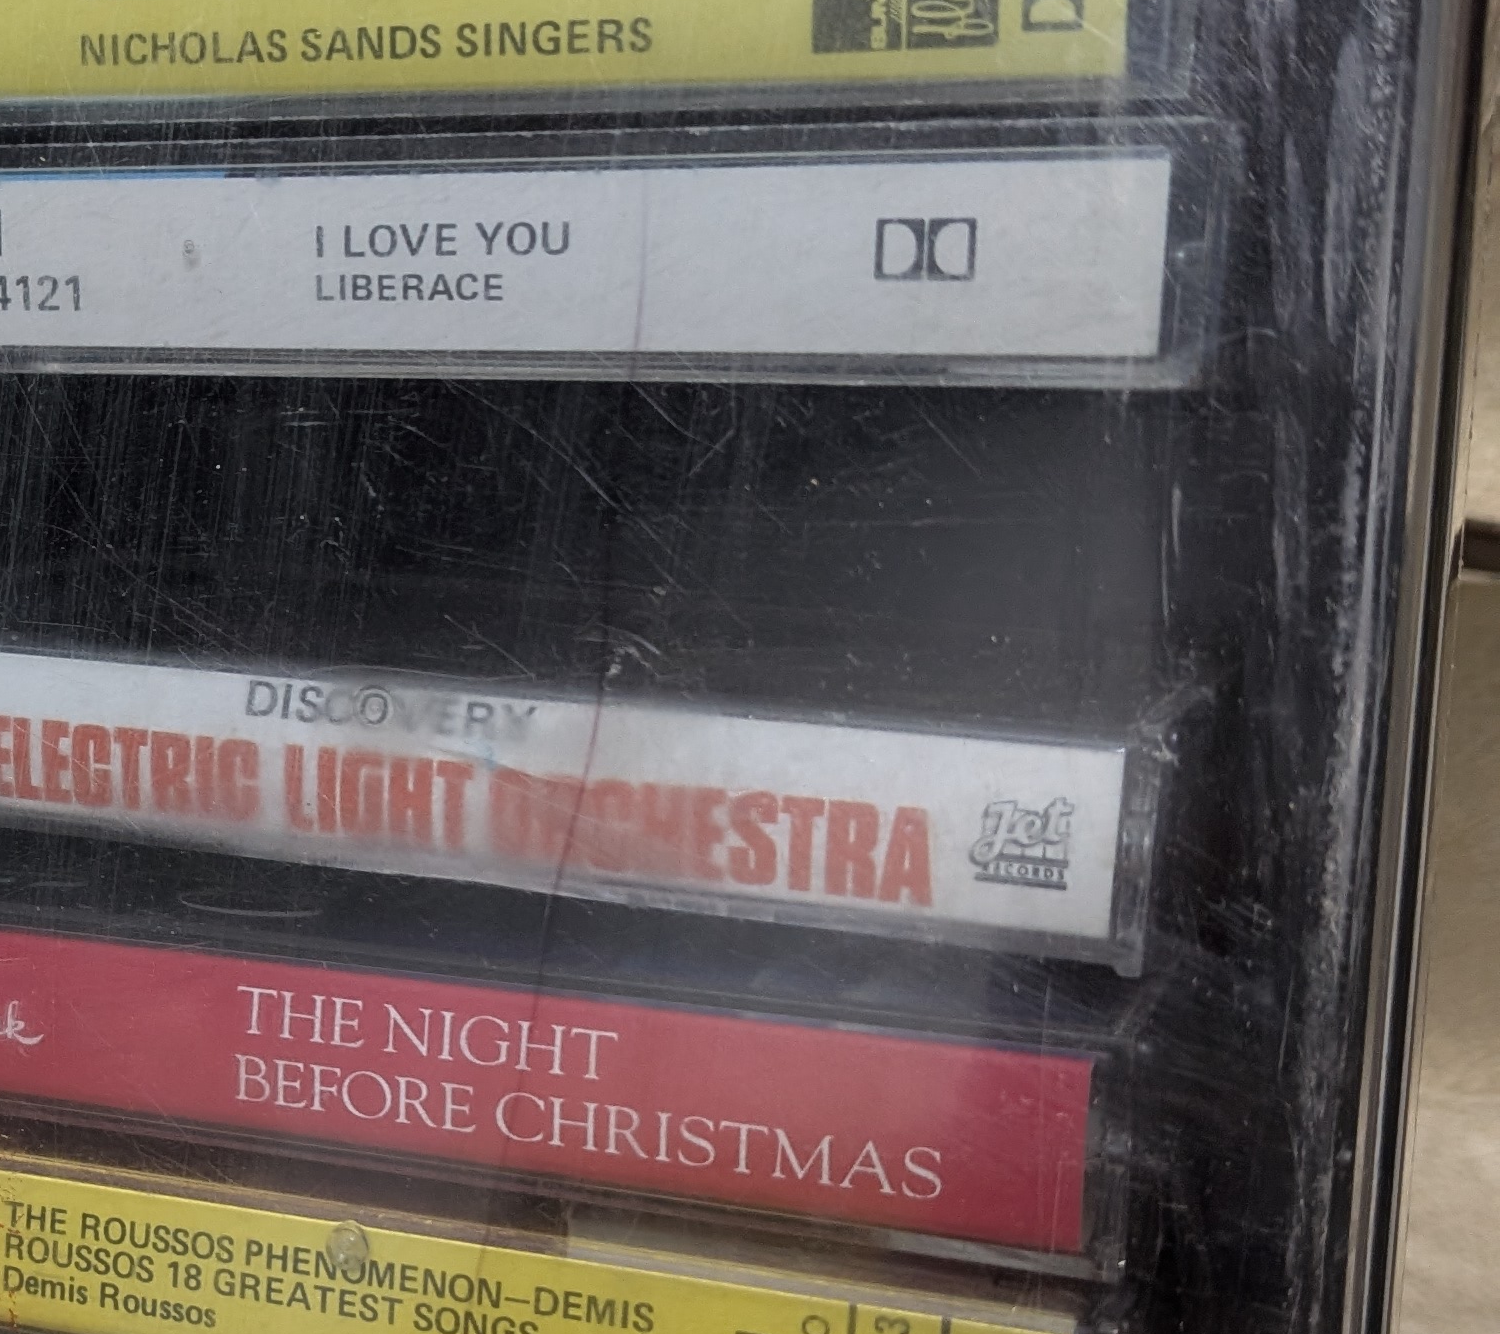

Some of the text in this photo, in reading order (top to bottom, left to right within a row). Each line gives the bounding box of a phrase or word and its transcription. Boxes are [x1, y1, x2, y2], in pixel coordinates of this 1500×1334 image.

[80, 16, 653, 69] NICHOLAS SANDS SINGERS
[315, 220, 571, 259] I LOVE YOU
[315, 273, 503, 303] LIBERACE
[236, 984, 618, 1080] THE NIGHT
[236, 1053, 942, 1200] BEFORE CHRISTMAS
[6, 1200, 234, 1265] THE ROUSSOS
[5, 1232, 154, 1283] ROUSSOS
[167, 1262, 202, 1294] 18
[213, 1268, 403, 1326] GREATEST
[5, 1268, 217, 1329] Demis Roussos
